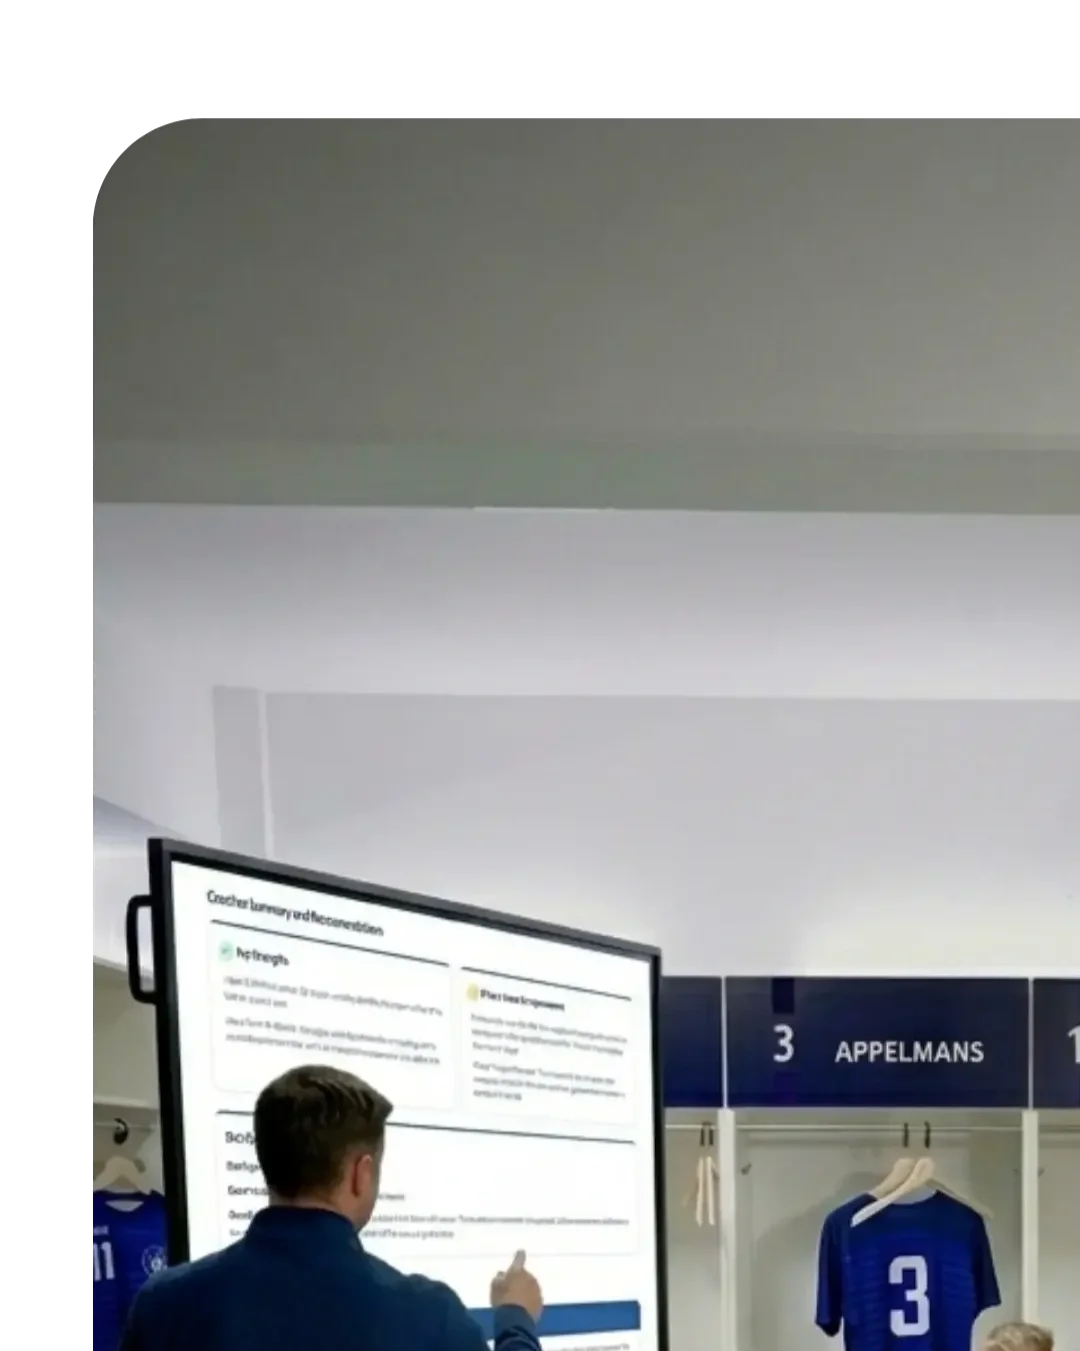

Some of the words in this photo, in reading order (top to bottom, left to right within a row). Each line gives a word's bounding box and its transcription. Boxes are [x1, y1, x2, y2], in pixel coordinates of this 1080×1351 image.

[773, 1024, 795, 1063] 3
[835, 1040, 984, 1063] APPELMANS
[889, 1255, 930, 1337] 3
